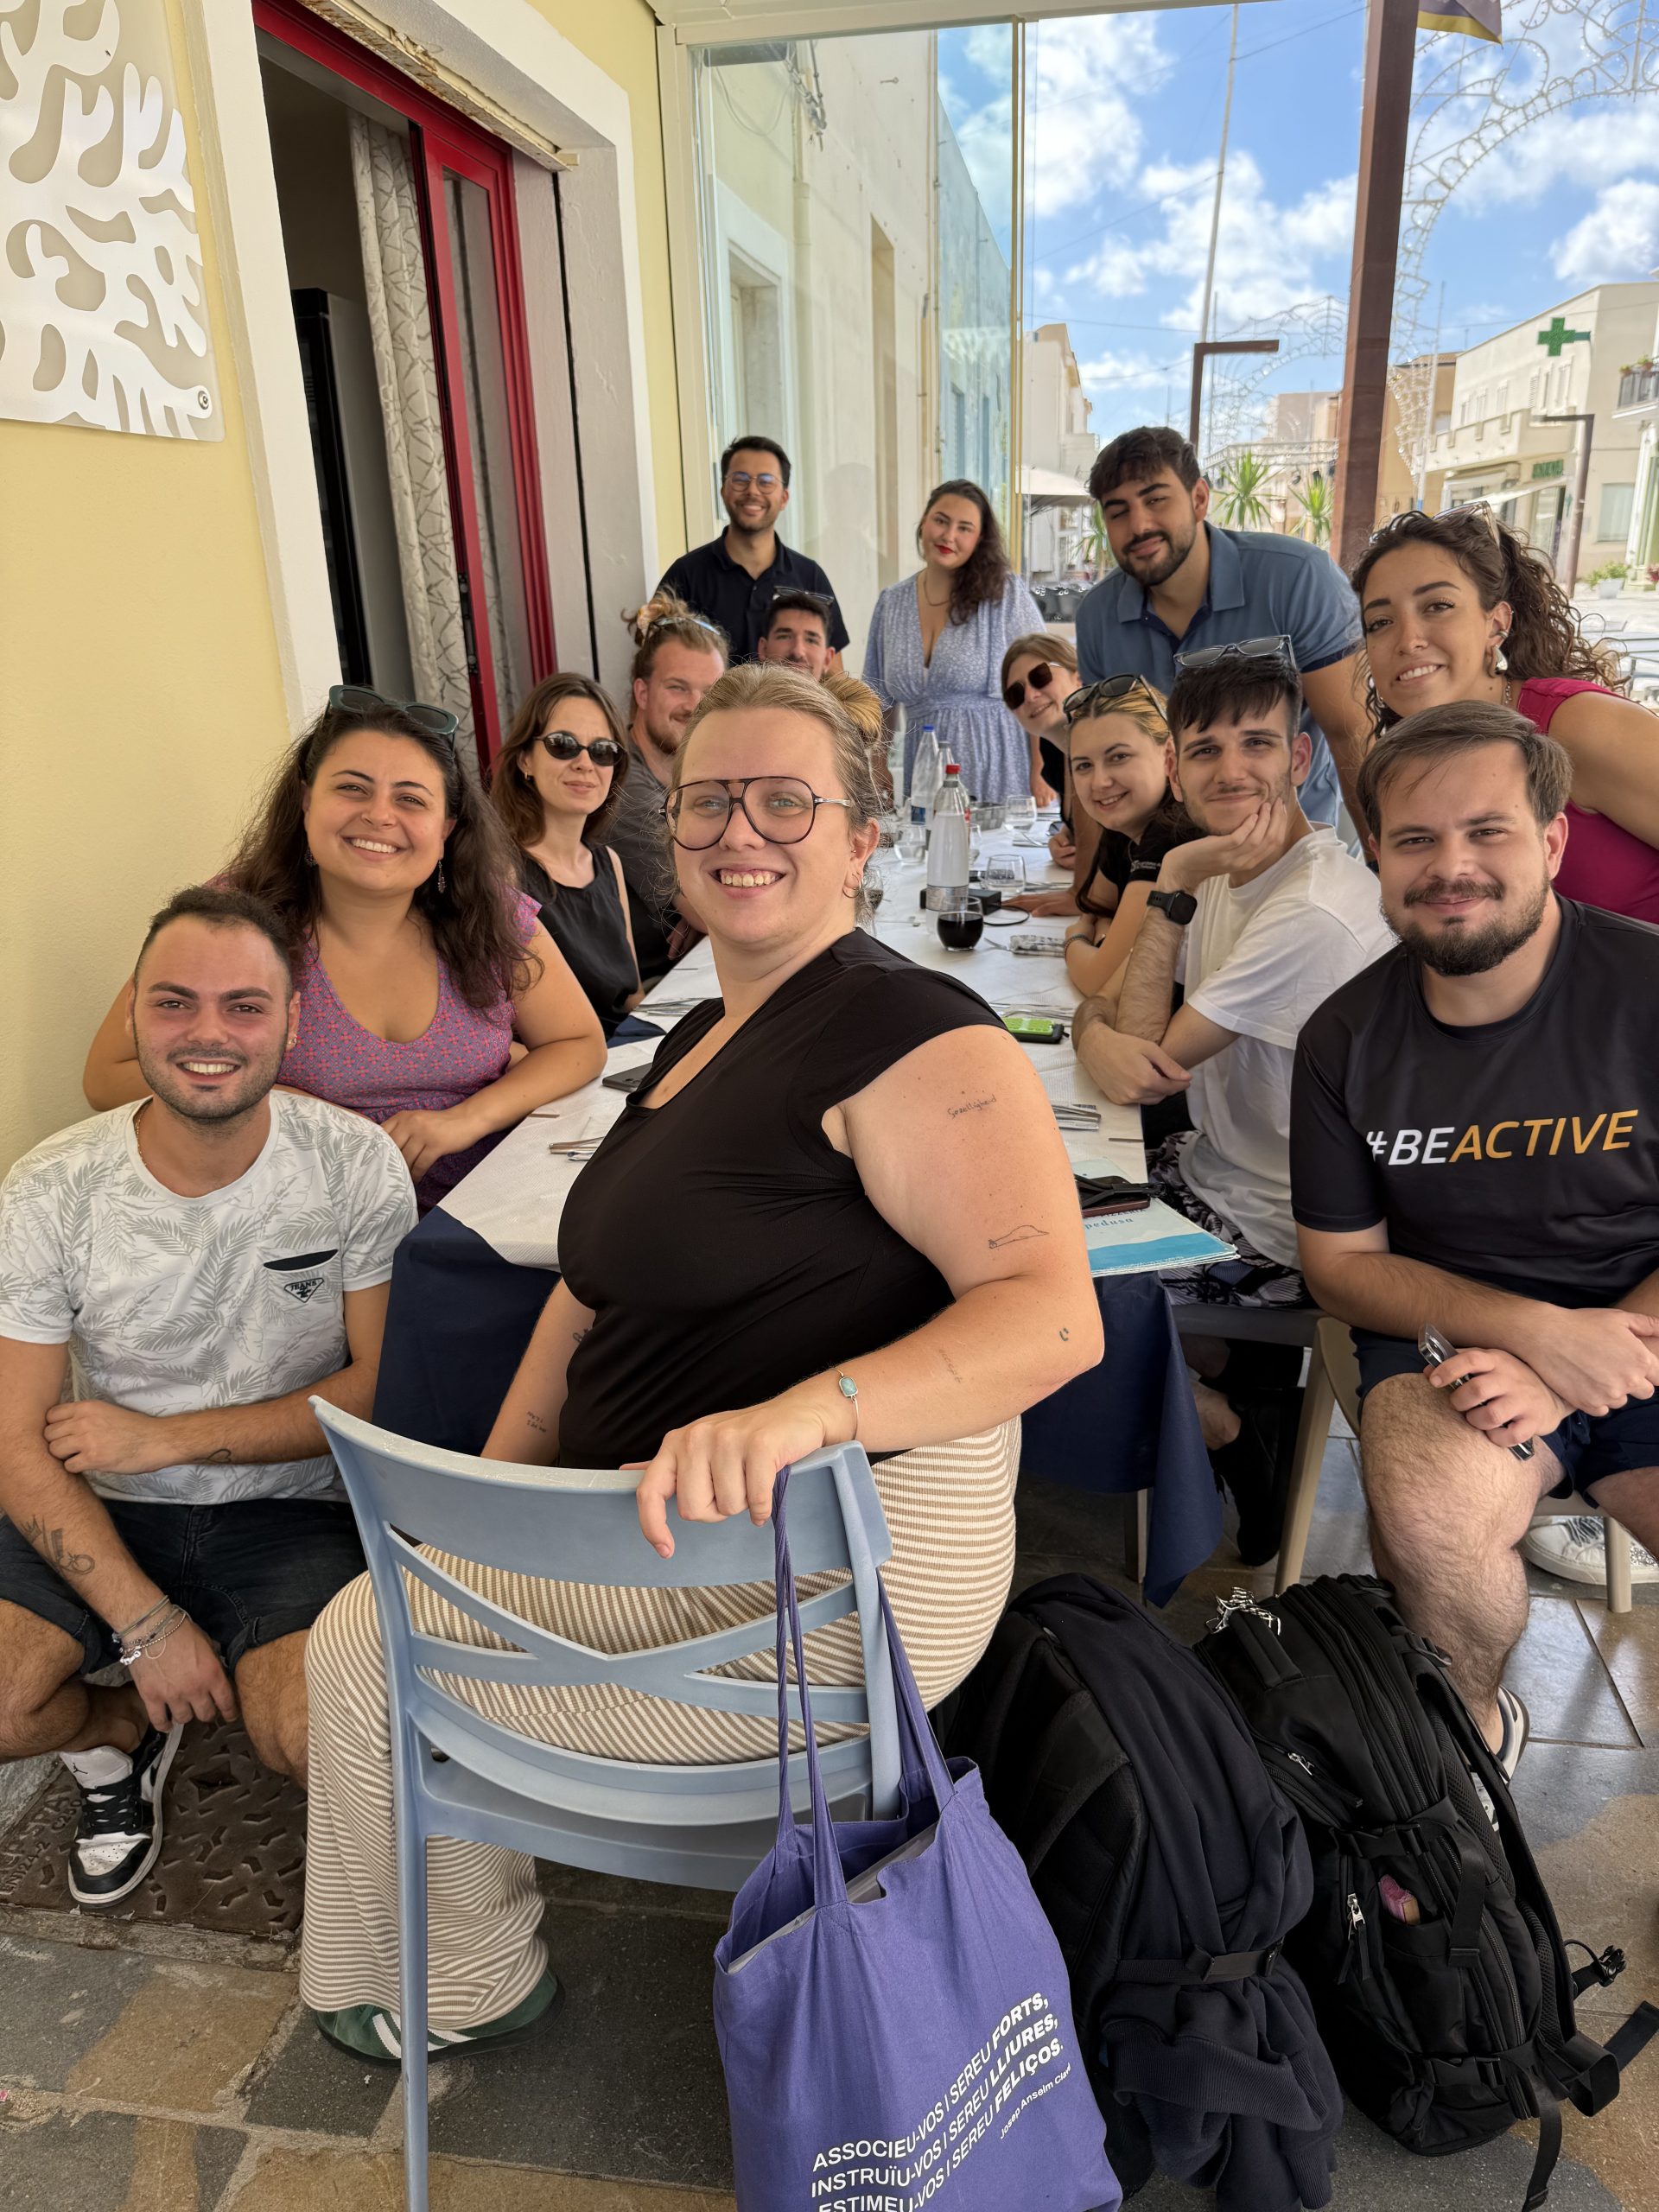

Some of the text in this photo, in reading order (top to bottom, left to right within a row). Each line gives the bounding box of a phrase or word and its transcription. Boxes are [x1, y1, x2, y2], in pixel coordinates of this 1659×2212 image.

[1366, 1109, 1638, 1166] #BEACTIVE
[291, 1281, 317, 1291] JEANS
[811, 2139, 942, 2198] INSTRUÏU-VOS
[948, 2077, 989, 2142] SEREU
[989, 2013, 1058, 2088] LLIURES,
[812, 2101, 944, 2172] ASSOCIEU-VOS
[950, 2041, 991, 2105] SEREU
[991, 1992, 1049, 2051] FORTS,
[952, 2104, 994, 2169] SEREU
[995, 2037, 1064, 2113] FELIÇOS.
[1000, 2107, 1020, 2139] Josep
[1020, 2081, 1054, 2110] Anselm
